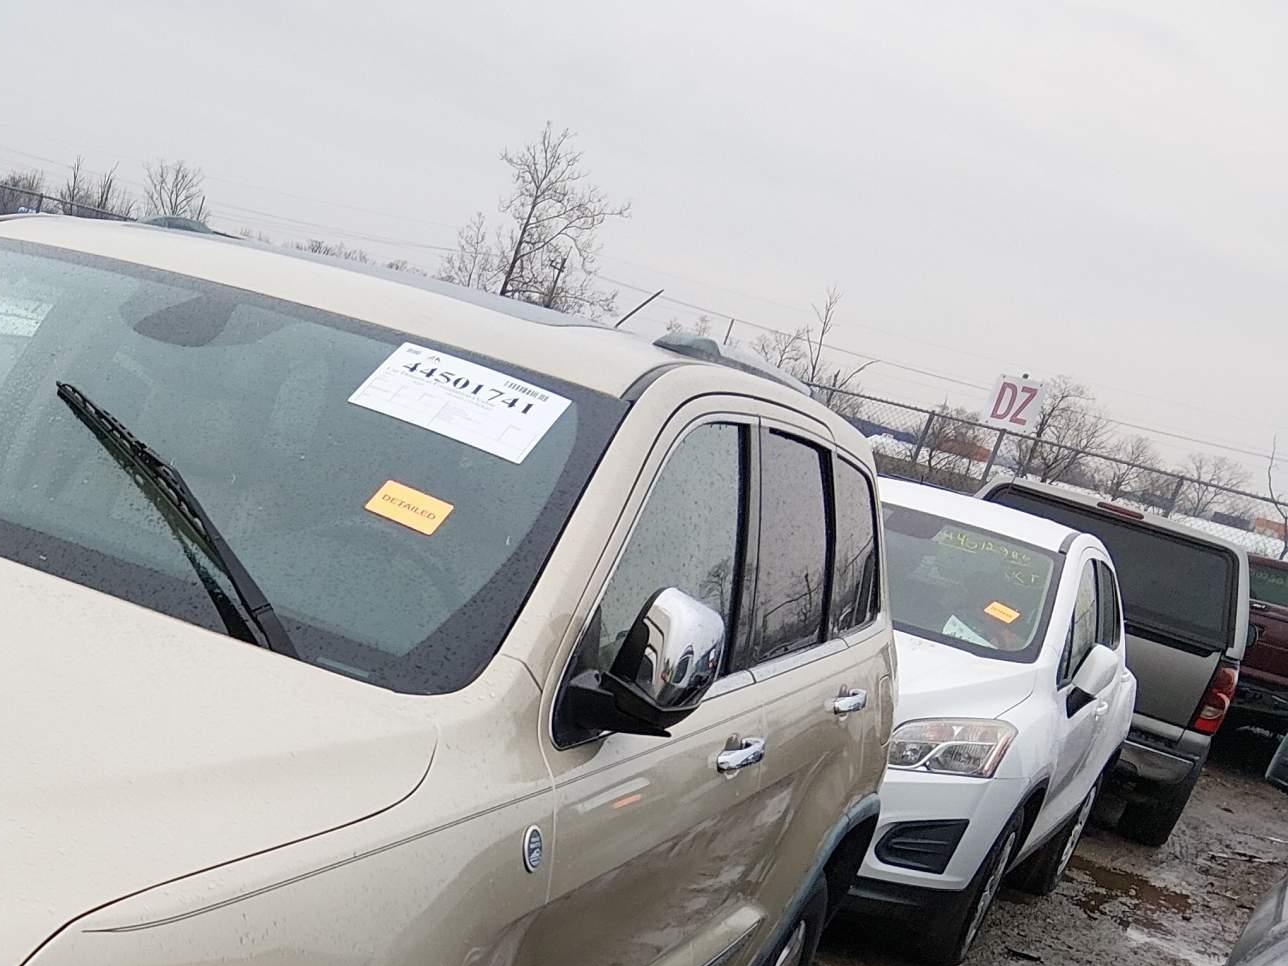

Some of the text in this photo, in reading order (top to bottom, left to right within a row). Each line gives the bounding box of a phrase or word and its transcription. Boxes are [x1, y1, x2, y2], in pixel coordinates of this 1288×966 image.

[402, 361, 535, 415] 44501741
[990, 381, 1039, 426] DZ
[381, 493, 437, 520] DETAILED
